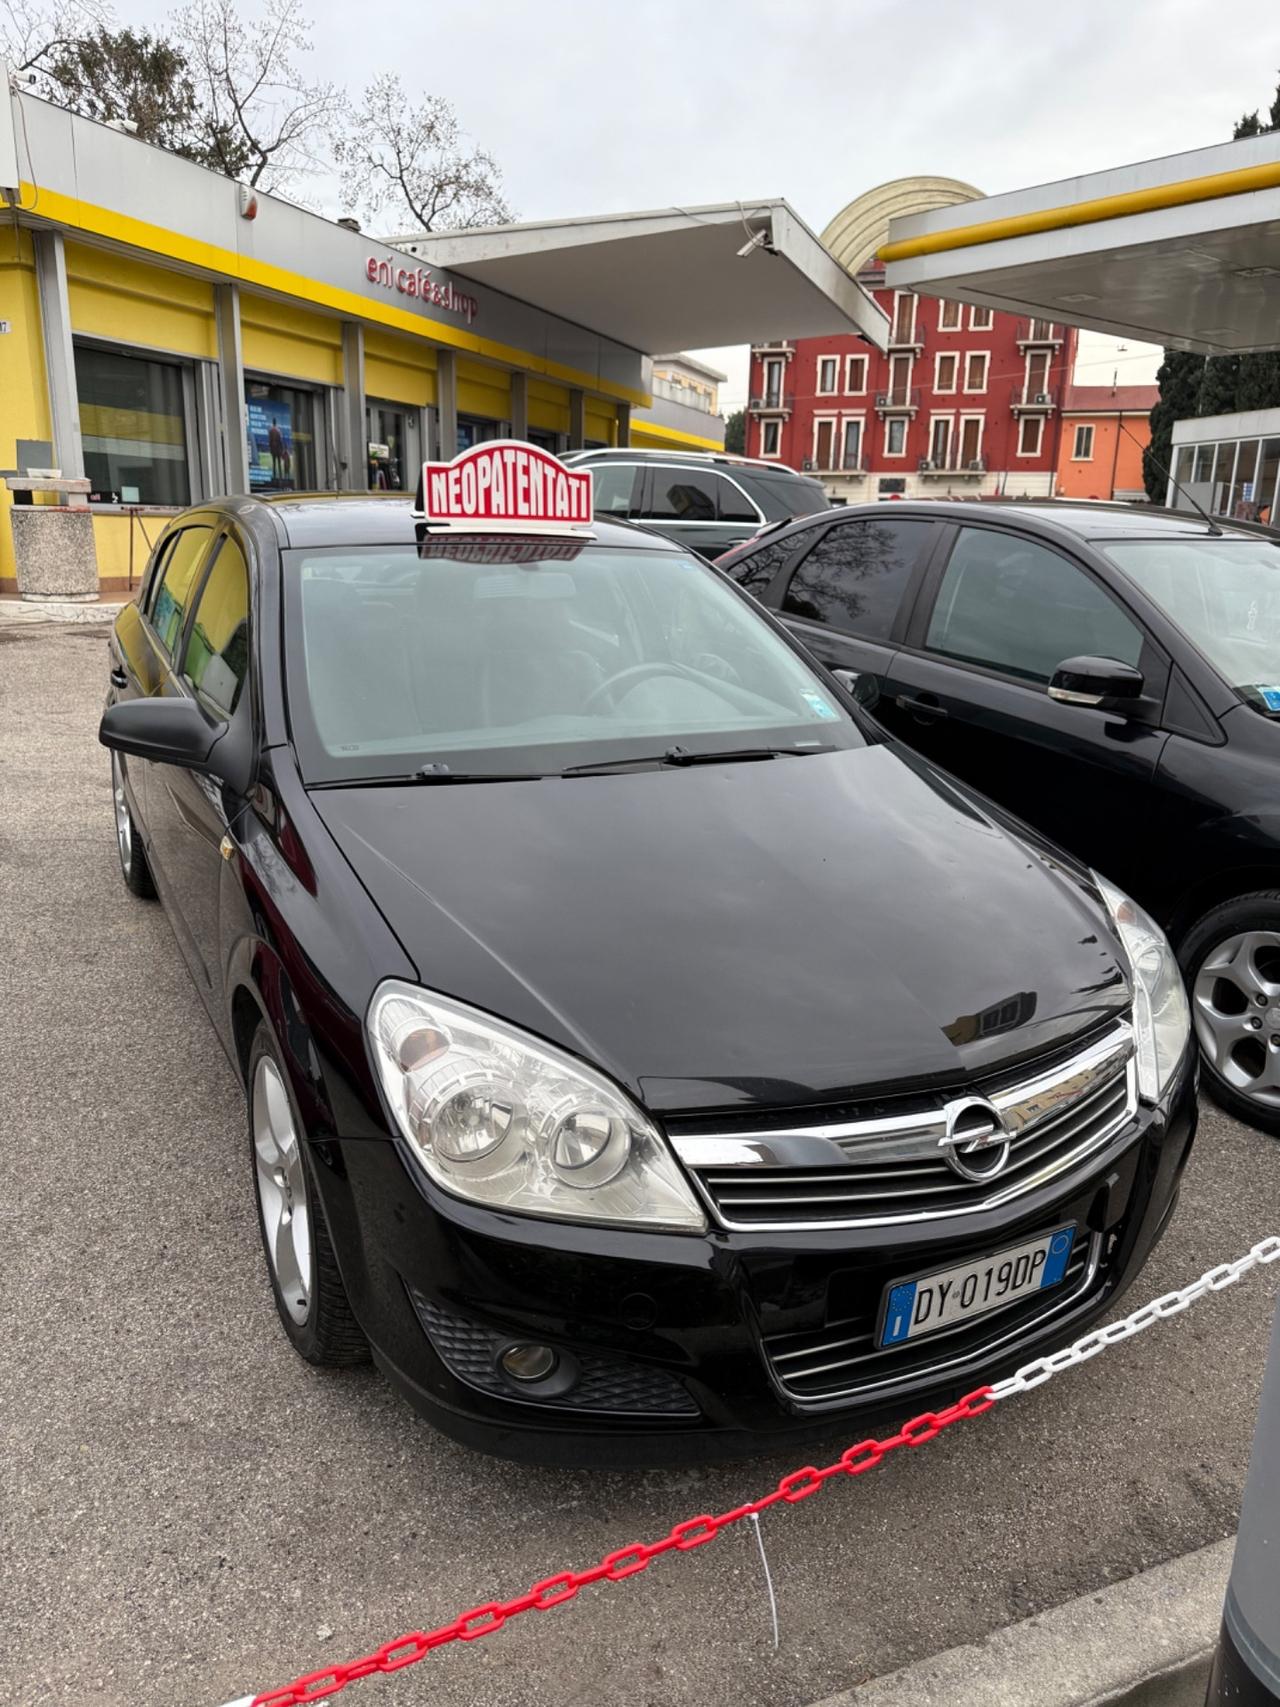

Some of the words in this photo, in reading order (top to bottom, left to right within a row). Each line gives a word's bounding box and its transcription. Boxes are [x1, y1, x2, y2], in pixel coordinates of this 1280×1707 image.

[365, 256, 393, 288] eni
[431, 449, 588, 519] NEOPATENTATI
[914, 1281, 953, 1325] DY
[960, 1250, 1046, 1309] 019DP
